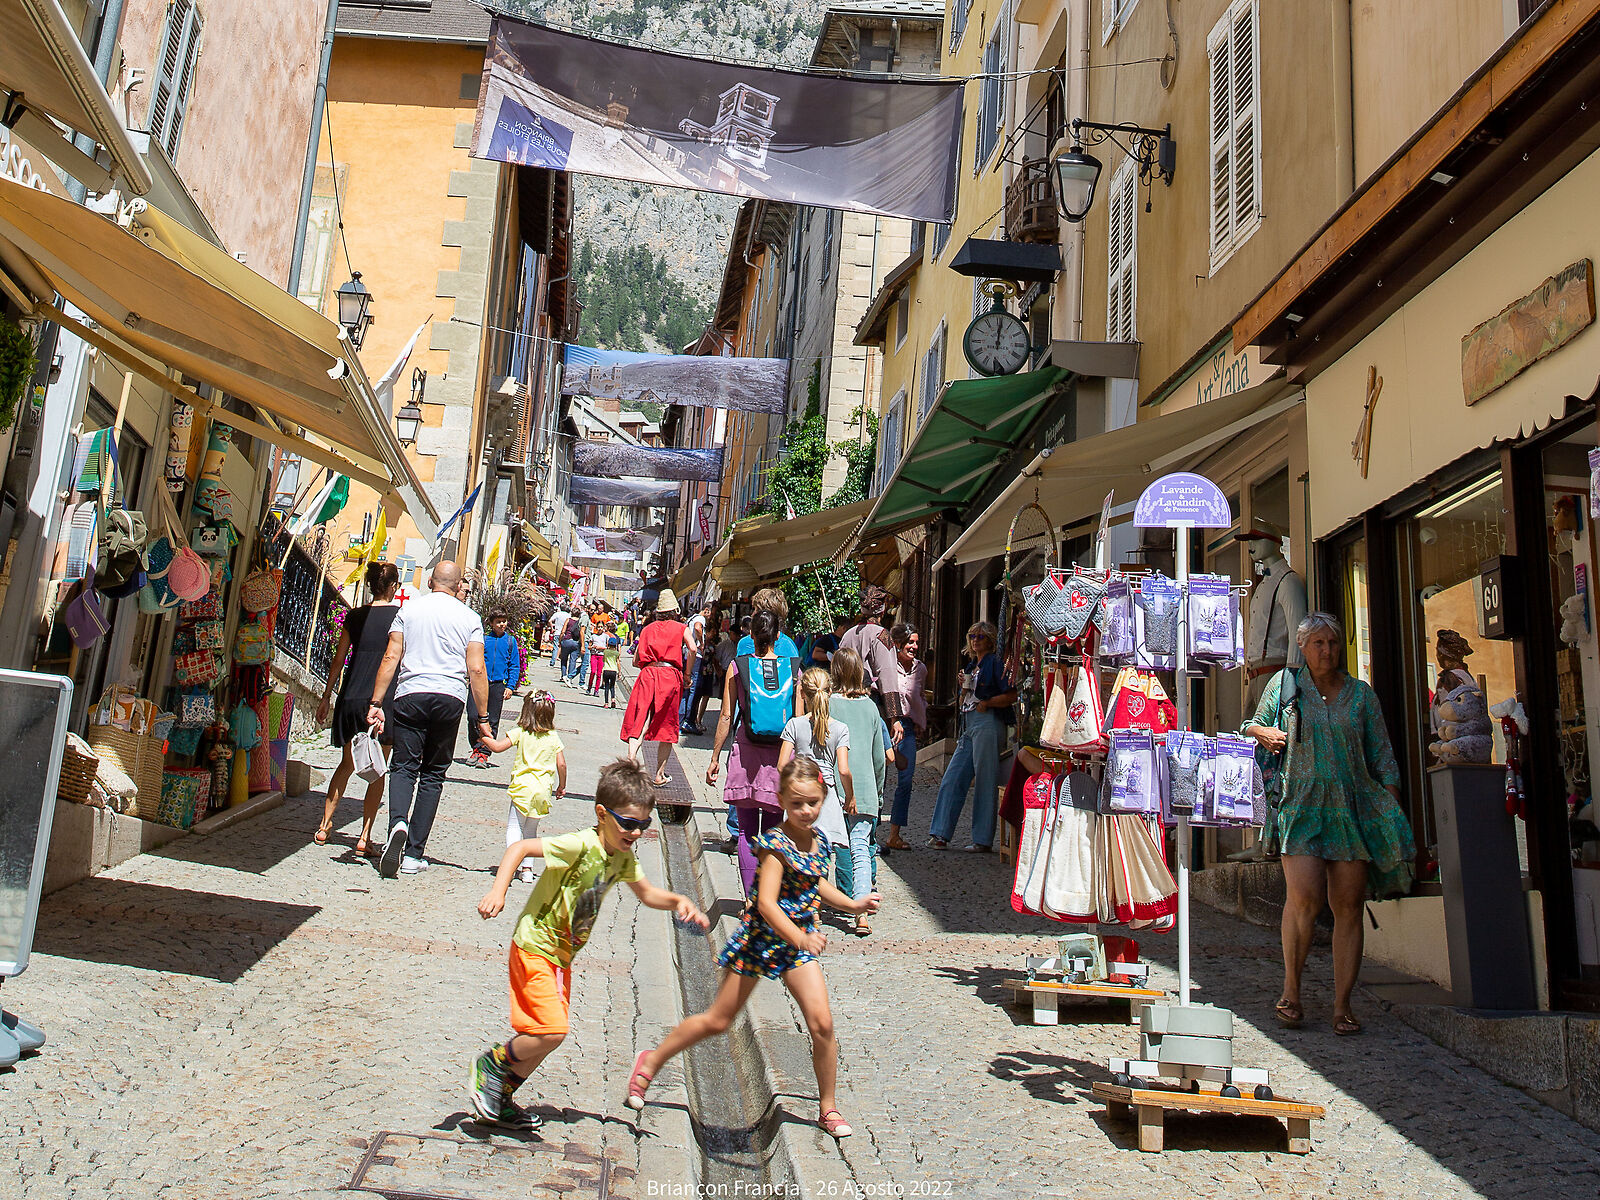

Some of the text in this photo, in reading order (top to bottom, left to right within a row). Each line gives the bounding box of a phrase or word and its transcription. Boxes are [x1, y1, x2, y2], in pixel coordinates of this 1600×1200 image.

[1160, 484, 1204, 494] Lavande
[1158, 497, 1206, 507] Lavandin
[1484, 584, 1499, 611] 60
